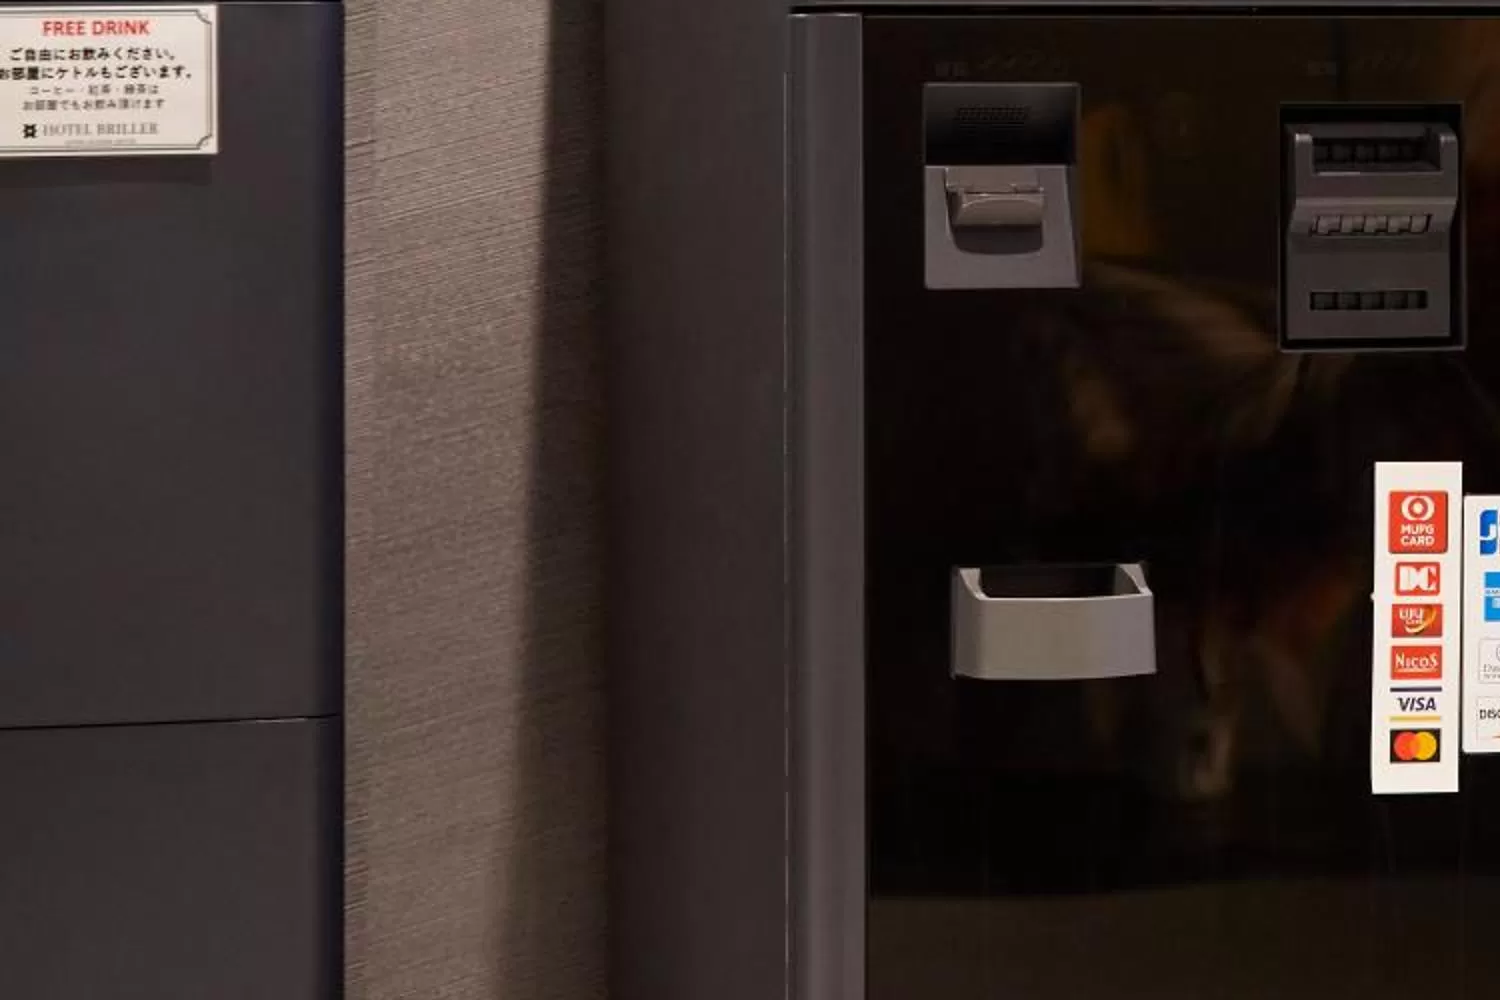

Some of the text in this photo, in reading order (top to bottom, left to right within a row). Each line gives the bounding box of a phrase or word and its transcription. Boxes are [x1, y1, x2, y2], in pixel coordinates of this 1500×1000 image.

[43, 21, 150, 36] FREE DRINK
[1401, 536, 1434, 546] CARD
[1399, 566, 1436, 591] DC
[1398, 697, 1436, 711] VISA
